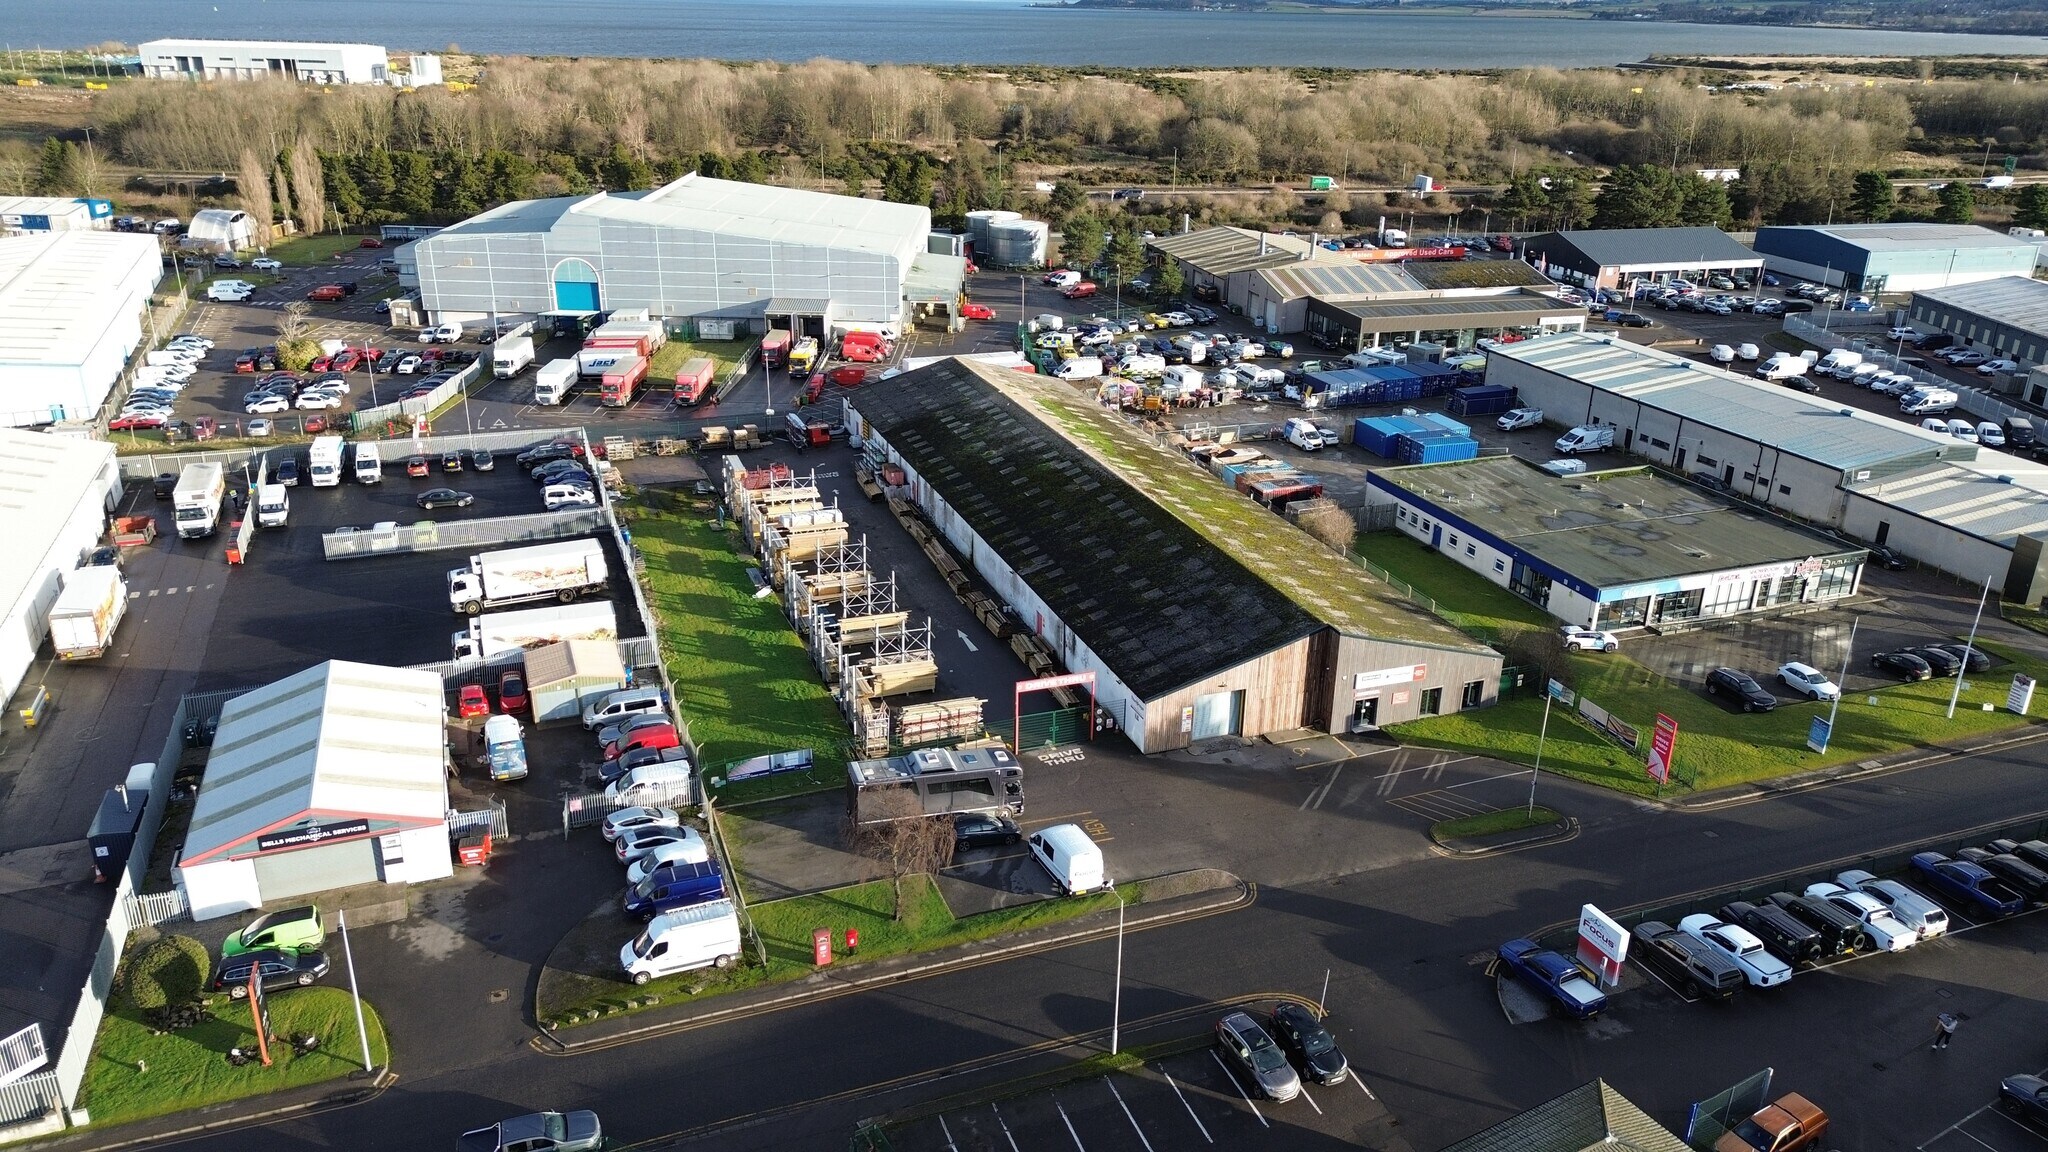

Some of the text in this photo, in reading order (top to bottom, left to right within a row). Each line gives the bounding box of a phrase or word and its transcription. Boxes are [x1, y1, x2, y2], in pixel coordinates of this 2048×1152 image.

[1384, 249, 1417, 258] Approved
[1420, 248, 1437, 256] Used
[1025, 675, 1086, 689] DRIVE THRU
[1655, 735, 1670, 746] DRIVE
[1655, 740, 1668, 751] THRU
[1037, 747, 1084, 761] DRIVE
[1044, 754, 1086, 766] THRU
[261, 825, 367, 848] BELLS MECHANICAL SERVICES
